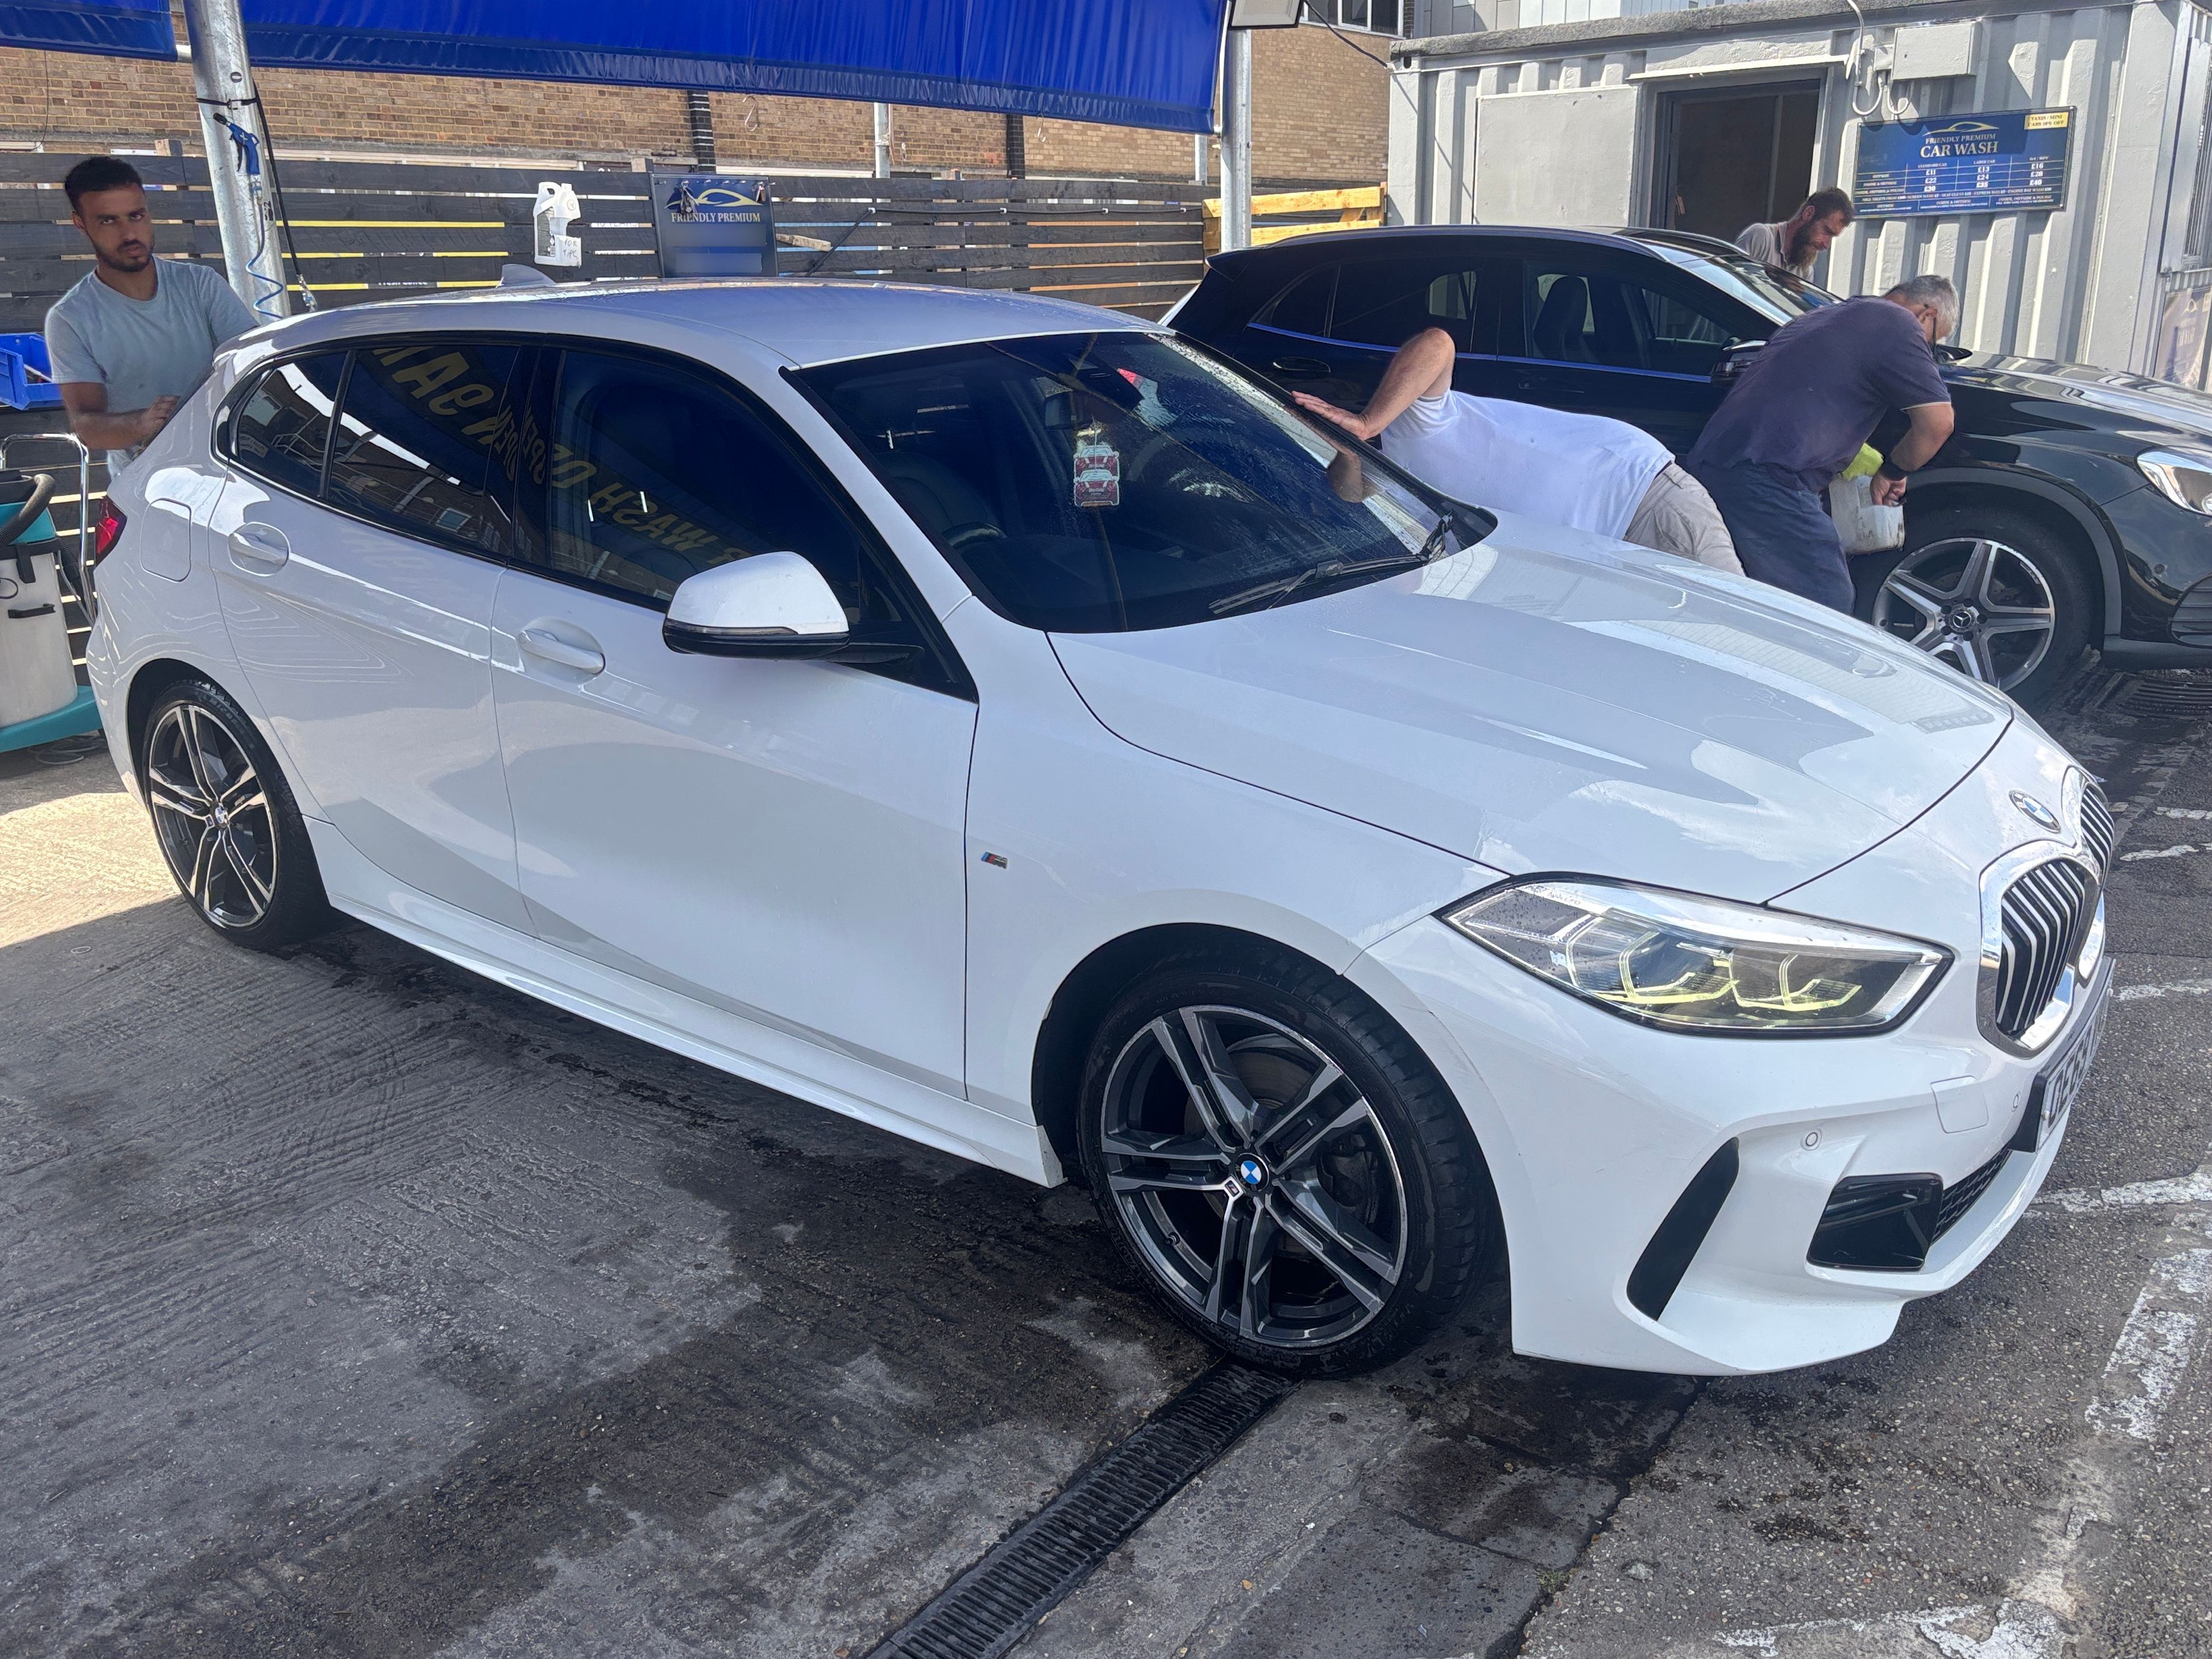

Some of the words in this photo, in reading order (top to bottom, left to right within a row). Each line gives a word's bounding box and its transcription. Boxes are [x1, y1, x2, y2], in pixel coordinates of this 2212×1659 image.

[1926, 136, 1960, 144] FRIENDLY
[1961, 133, 1996, 142] PREMIUM
[1920, 144, 1951, 158] CAR
[1954, 141, 1999, 156] WASH
[671, 213, 716, 223] FRIENDLY
[718, 213, 761, 223] PREMIUM
[564, 239, 578, 247] FOR
